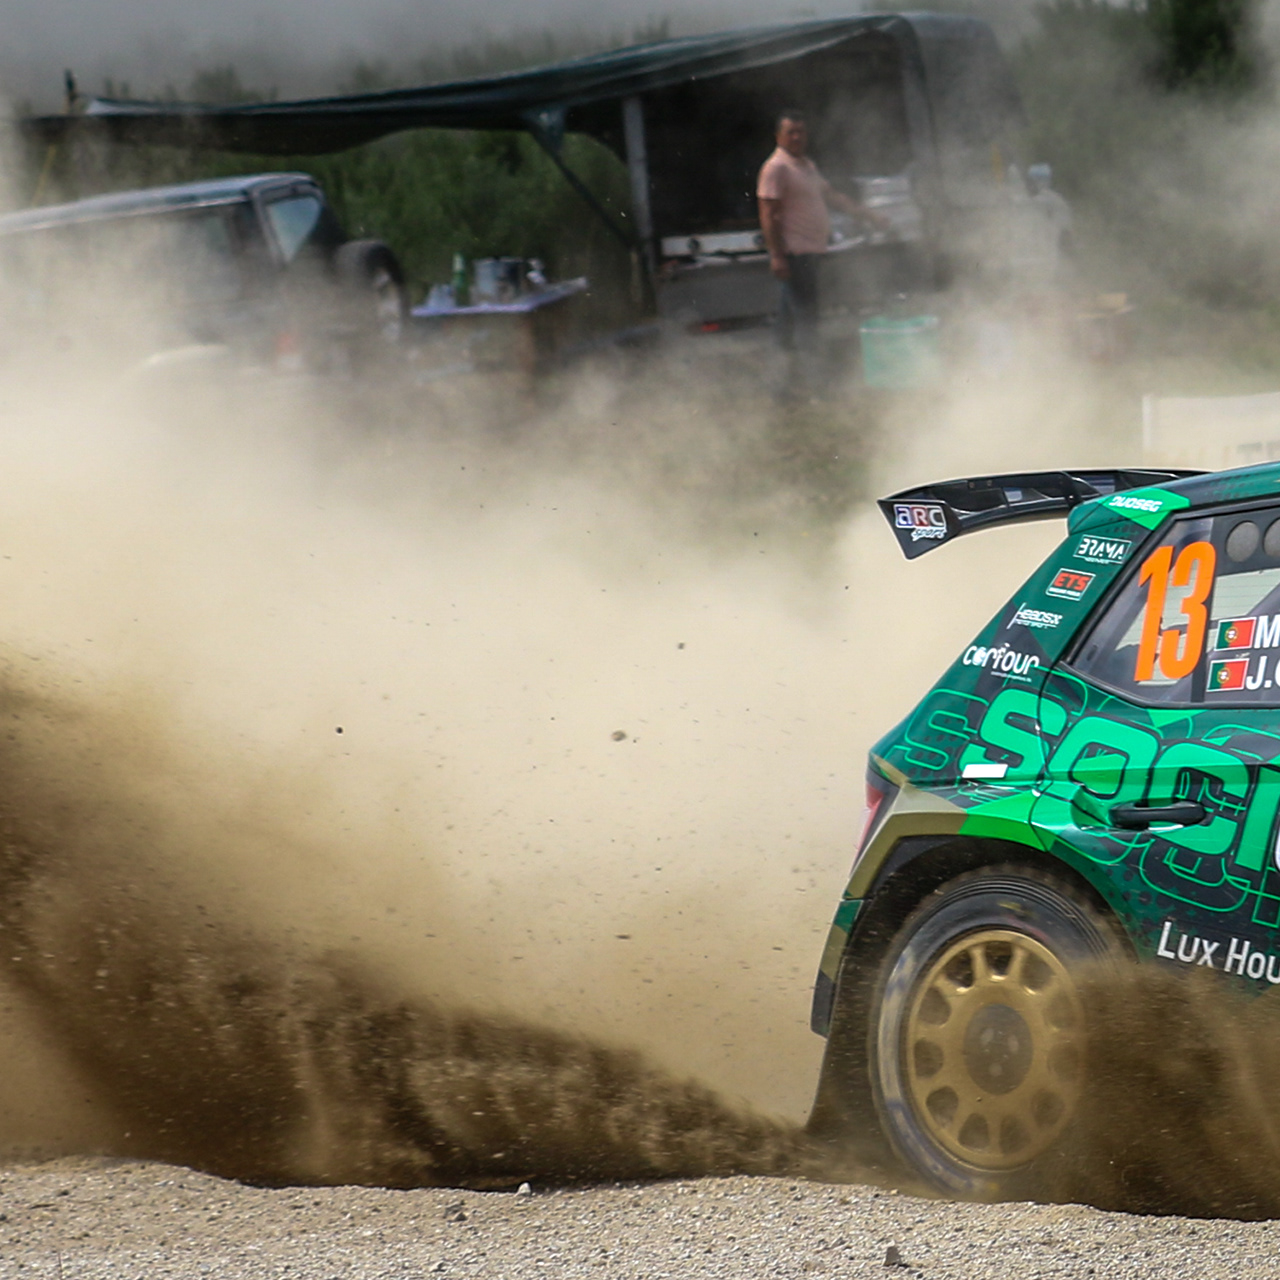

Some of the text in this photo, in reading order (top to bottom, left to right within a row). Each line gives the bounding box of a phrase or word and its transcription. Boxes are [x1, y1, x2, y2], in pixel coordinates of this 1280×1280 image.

[1053, 572, 1091, 591] ETS
[1133, 540, 1217, 687] 13
[1156, 921, 1216, 967] Lux
